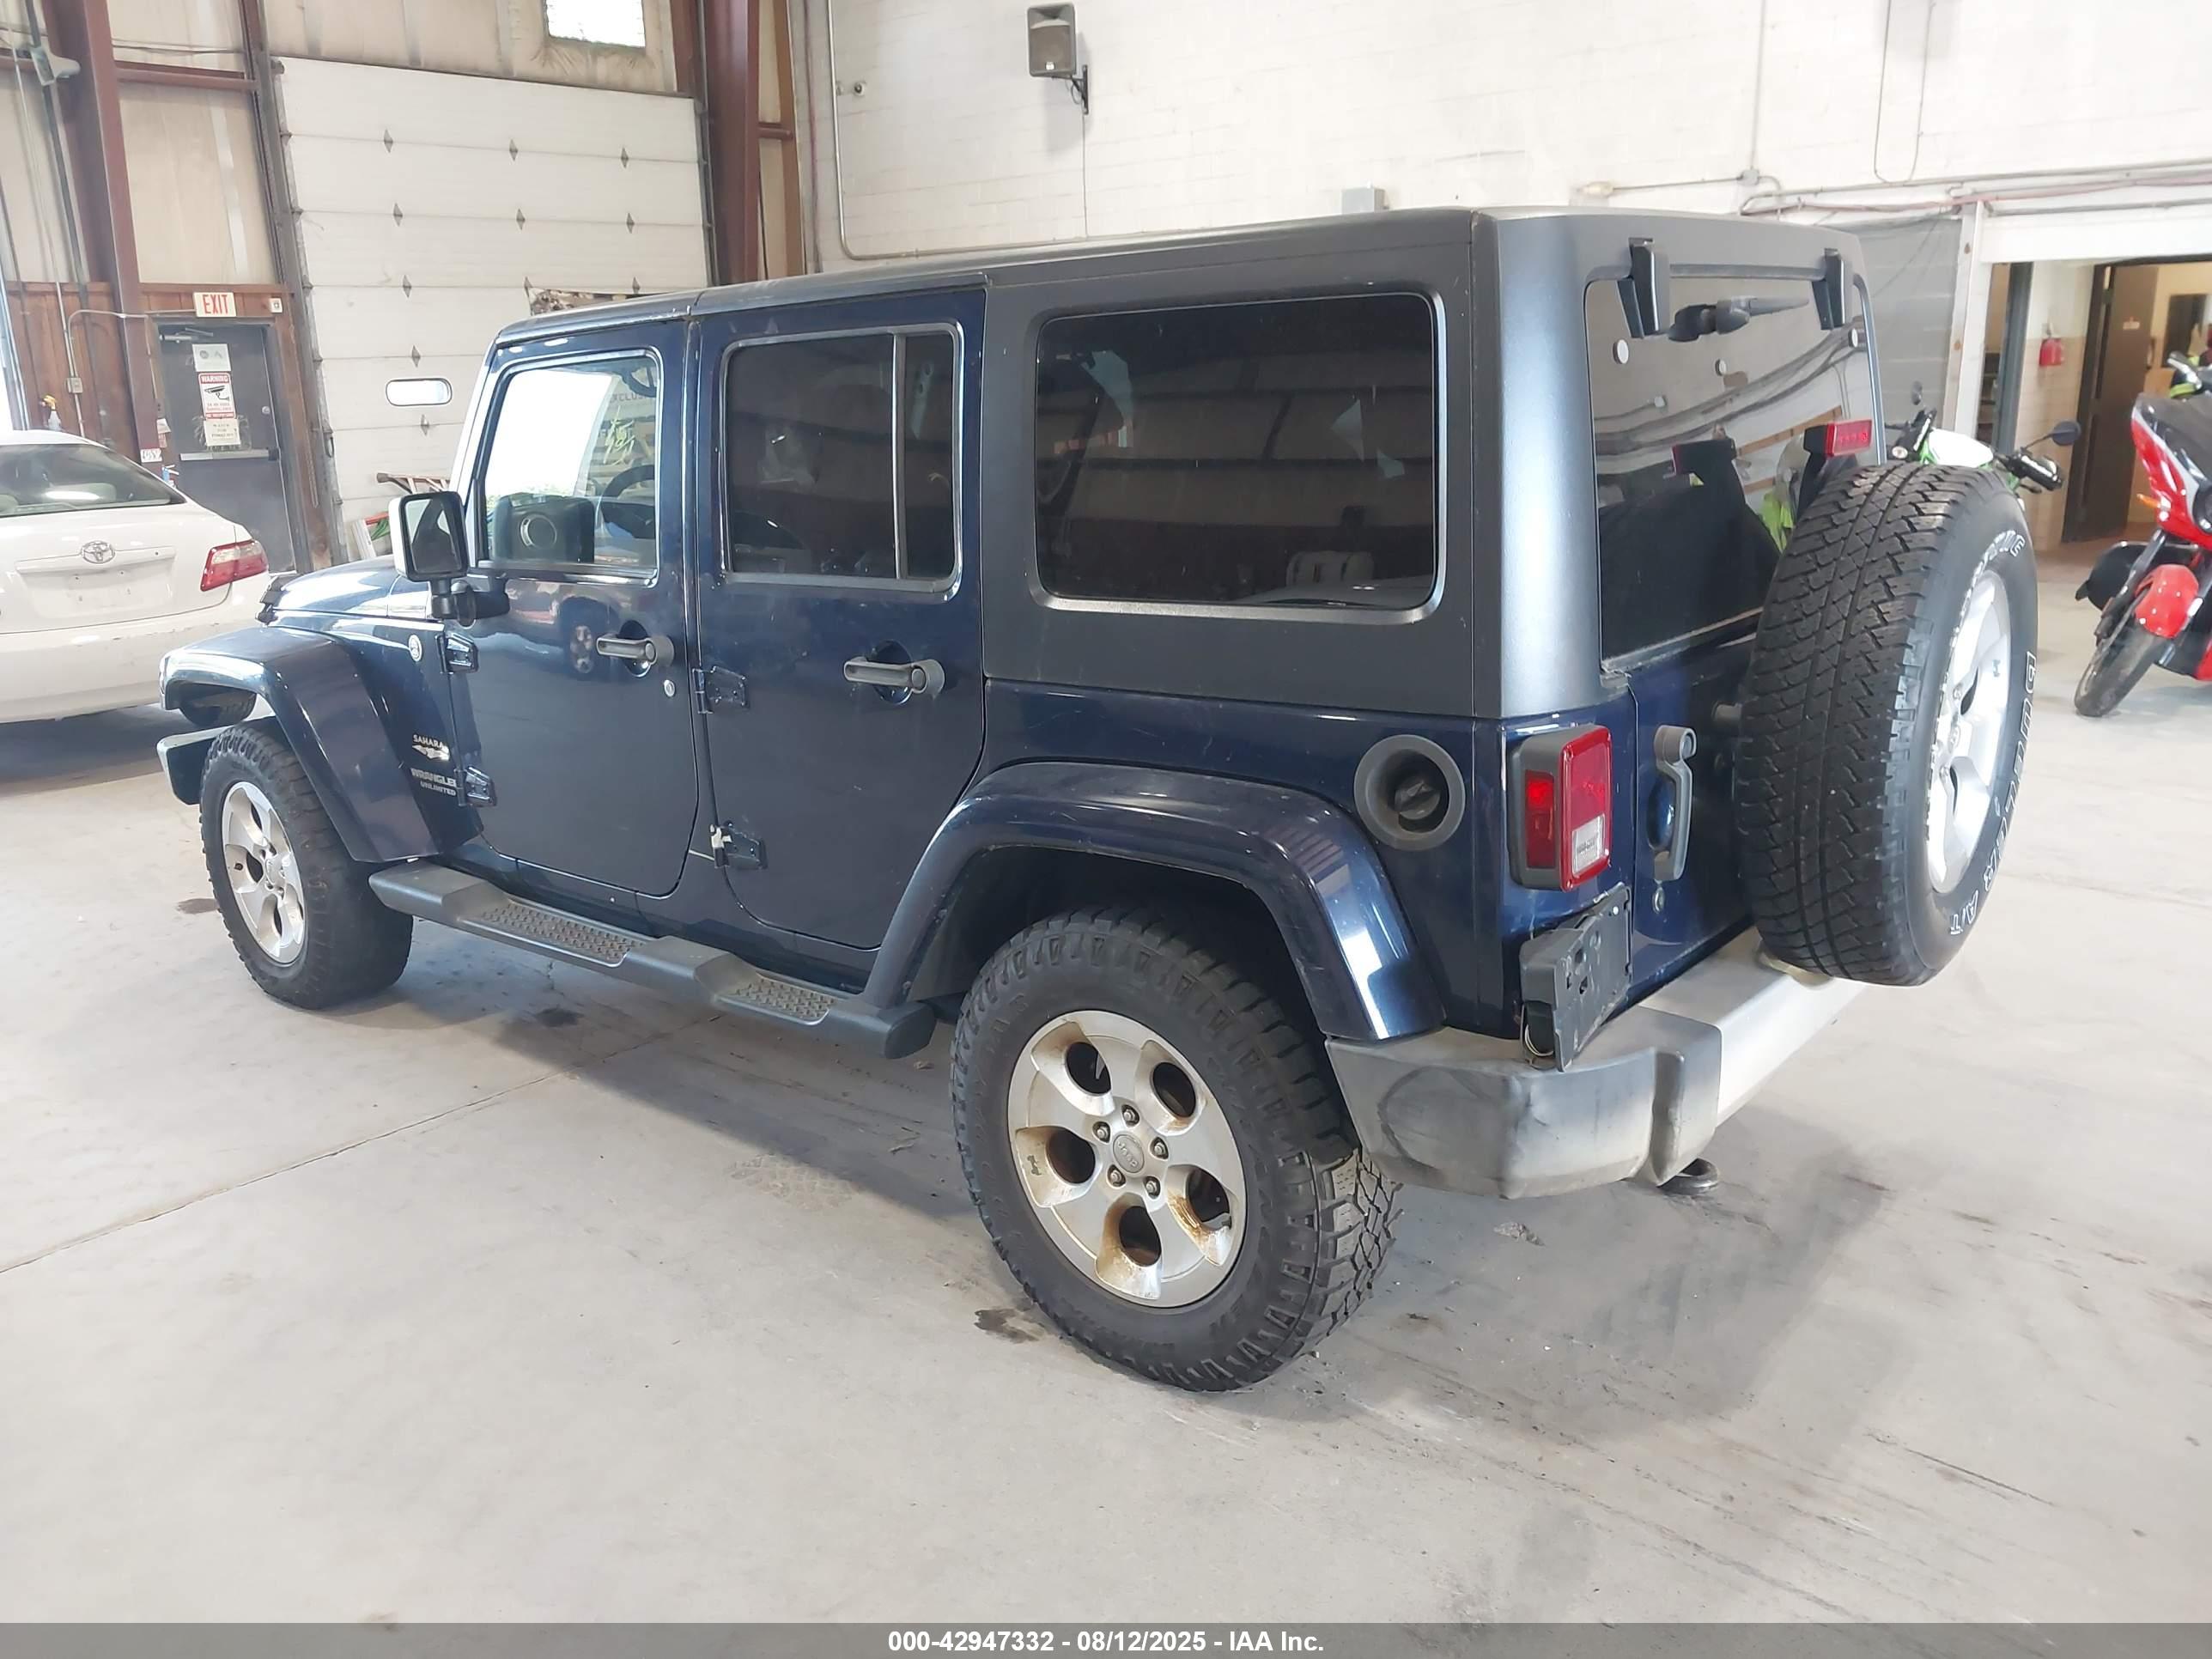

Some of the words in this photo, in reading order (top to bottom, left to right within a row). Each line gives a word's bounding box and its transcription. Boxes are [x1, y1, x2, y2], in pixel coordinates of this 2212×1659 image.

[202, 294, 228, 314] EXIT
[201, 374, 228, 384] WARNING
[412, 734, 445, 750] SAHARA
